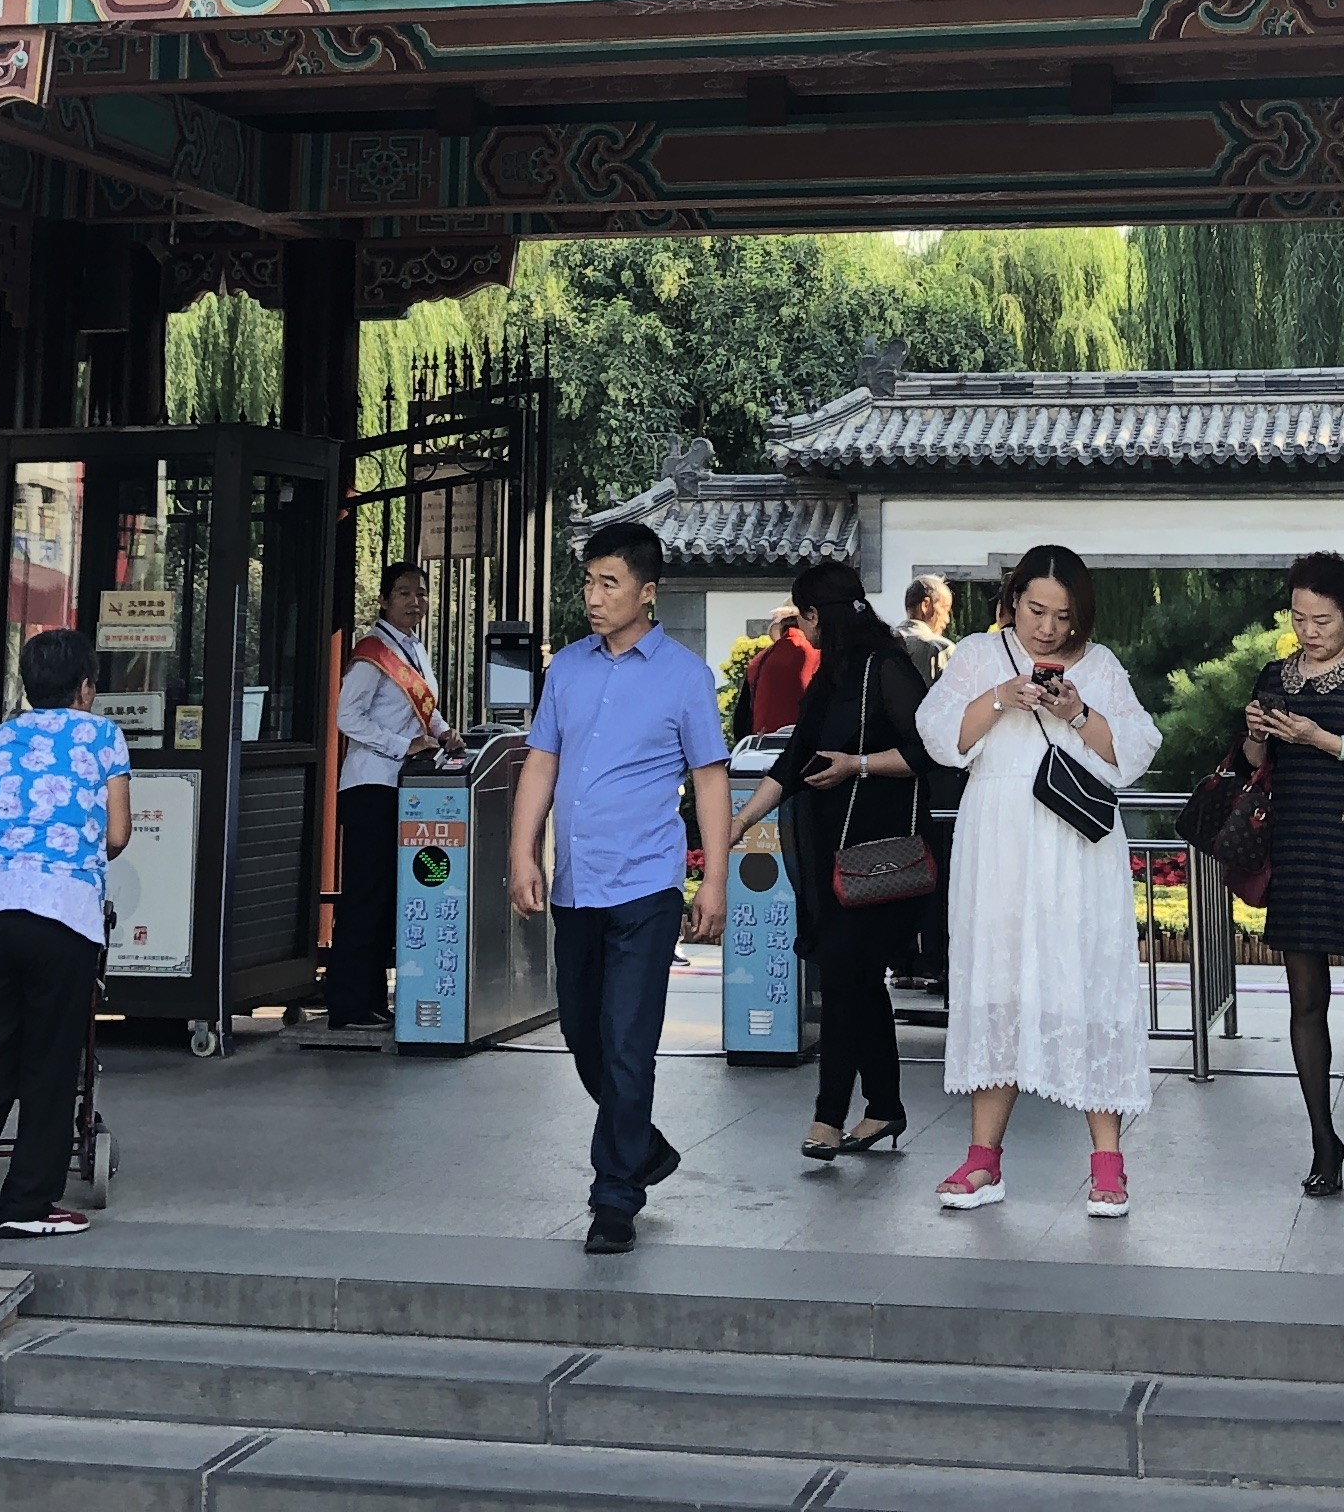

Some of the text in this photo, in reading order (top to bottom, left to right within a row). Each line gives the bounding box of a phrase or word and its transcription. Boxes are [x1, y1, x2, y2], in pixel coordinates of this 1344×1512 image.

[403, 838, 459, 846] ENTRANCE
[416, 823, 449, 838] 入口
[404, 898, 428, 950] 祝您
[435, 897, 459, 997] 游玩愉快
[732, 903, 757, 956] 祝您
[765, 902, 790, 1004] 游玩愉快
